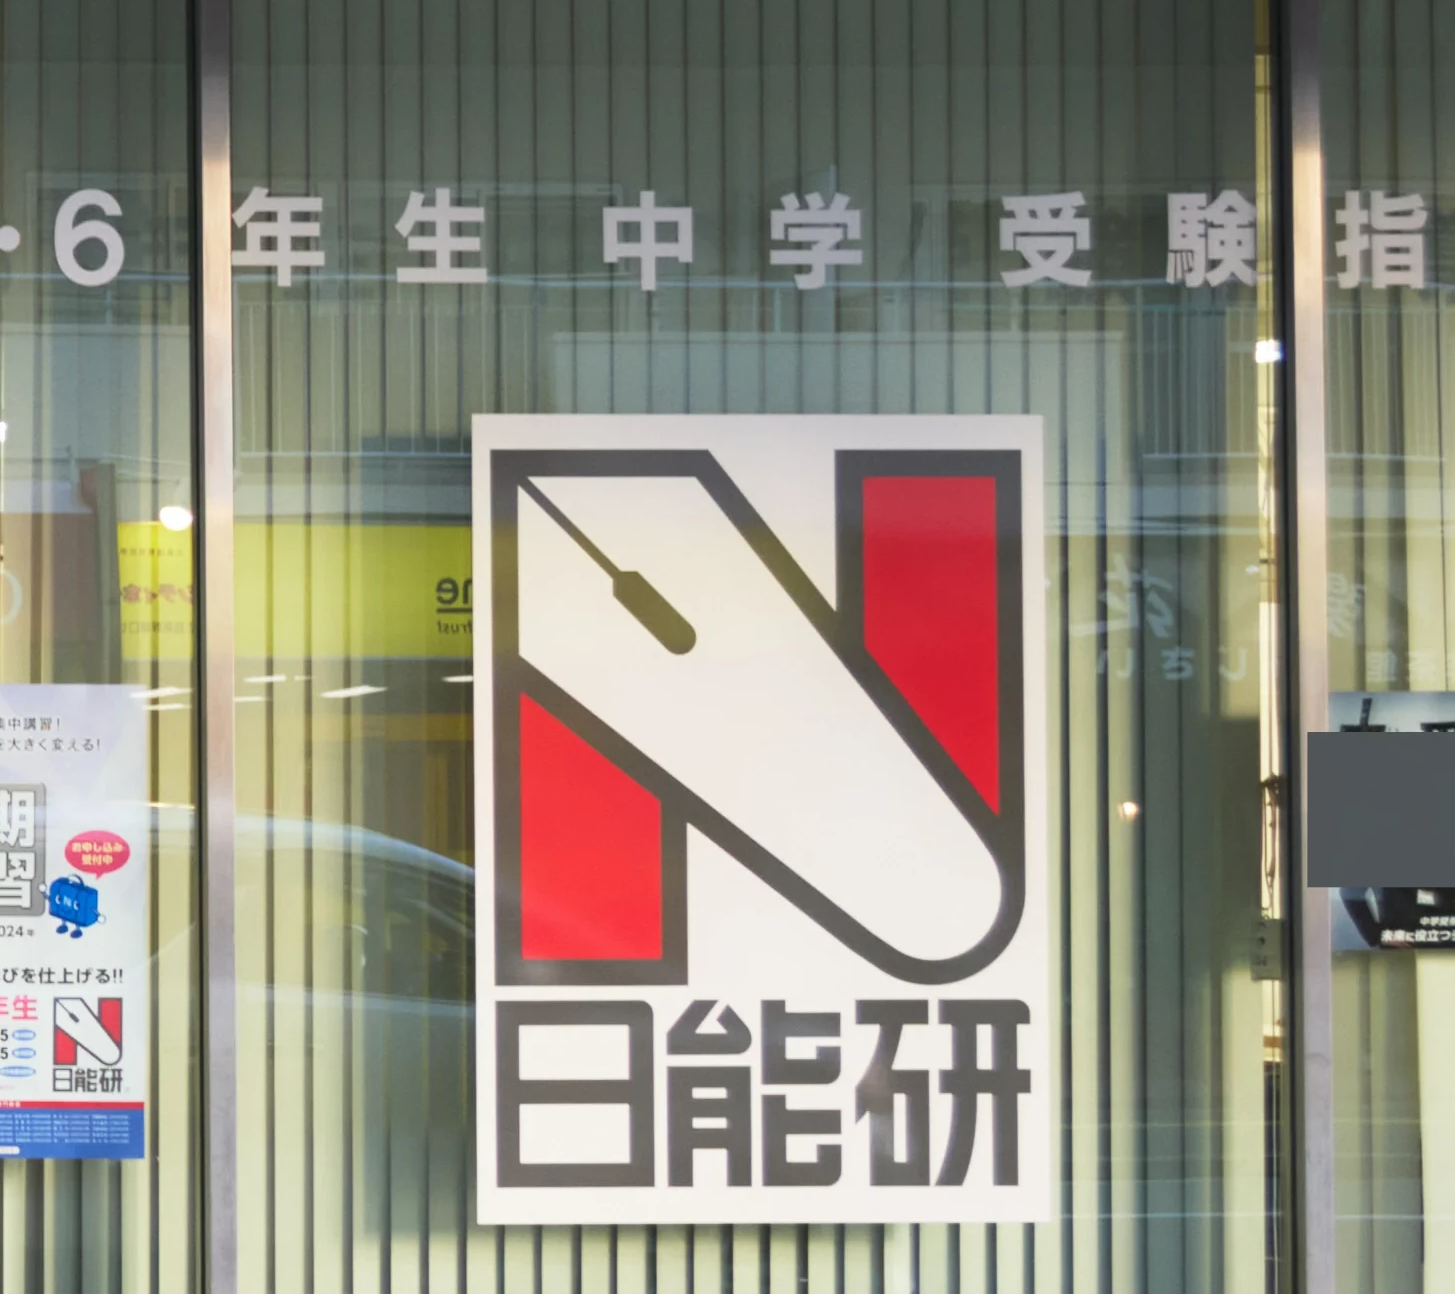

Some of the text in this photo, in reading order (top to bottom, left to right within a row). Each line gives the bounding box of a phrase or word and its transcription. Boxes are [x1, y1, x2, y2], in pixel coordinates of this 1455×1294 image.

[52, 1068, 123, 1093] 日能研
[494, 997, 1032, 1189] 日能研
